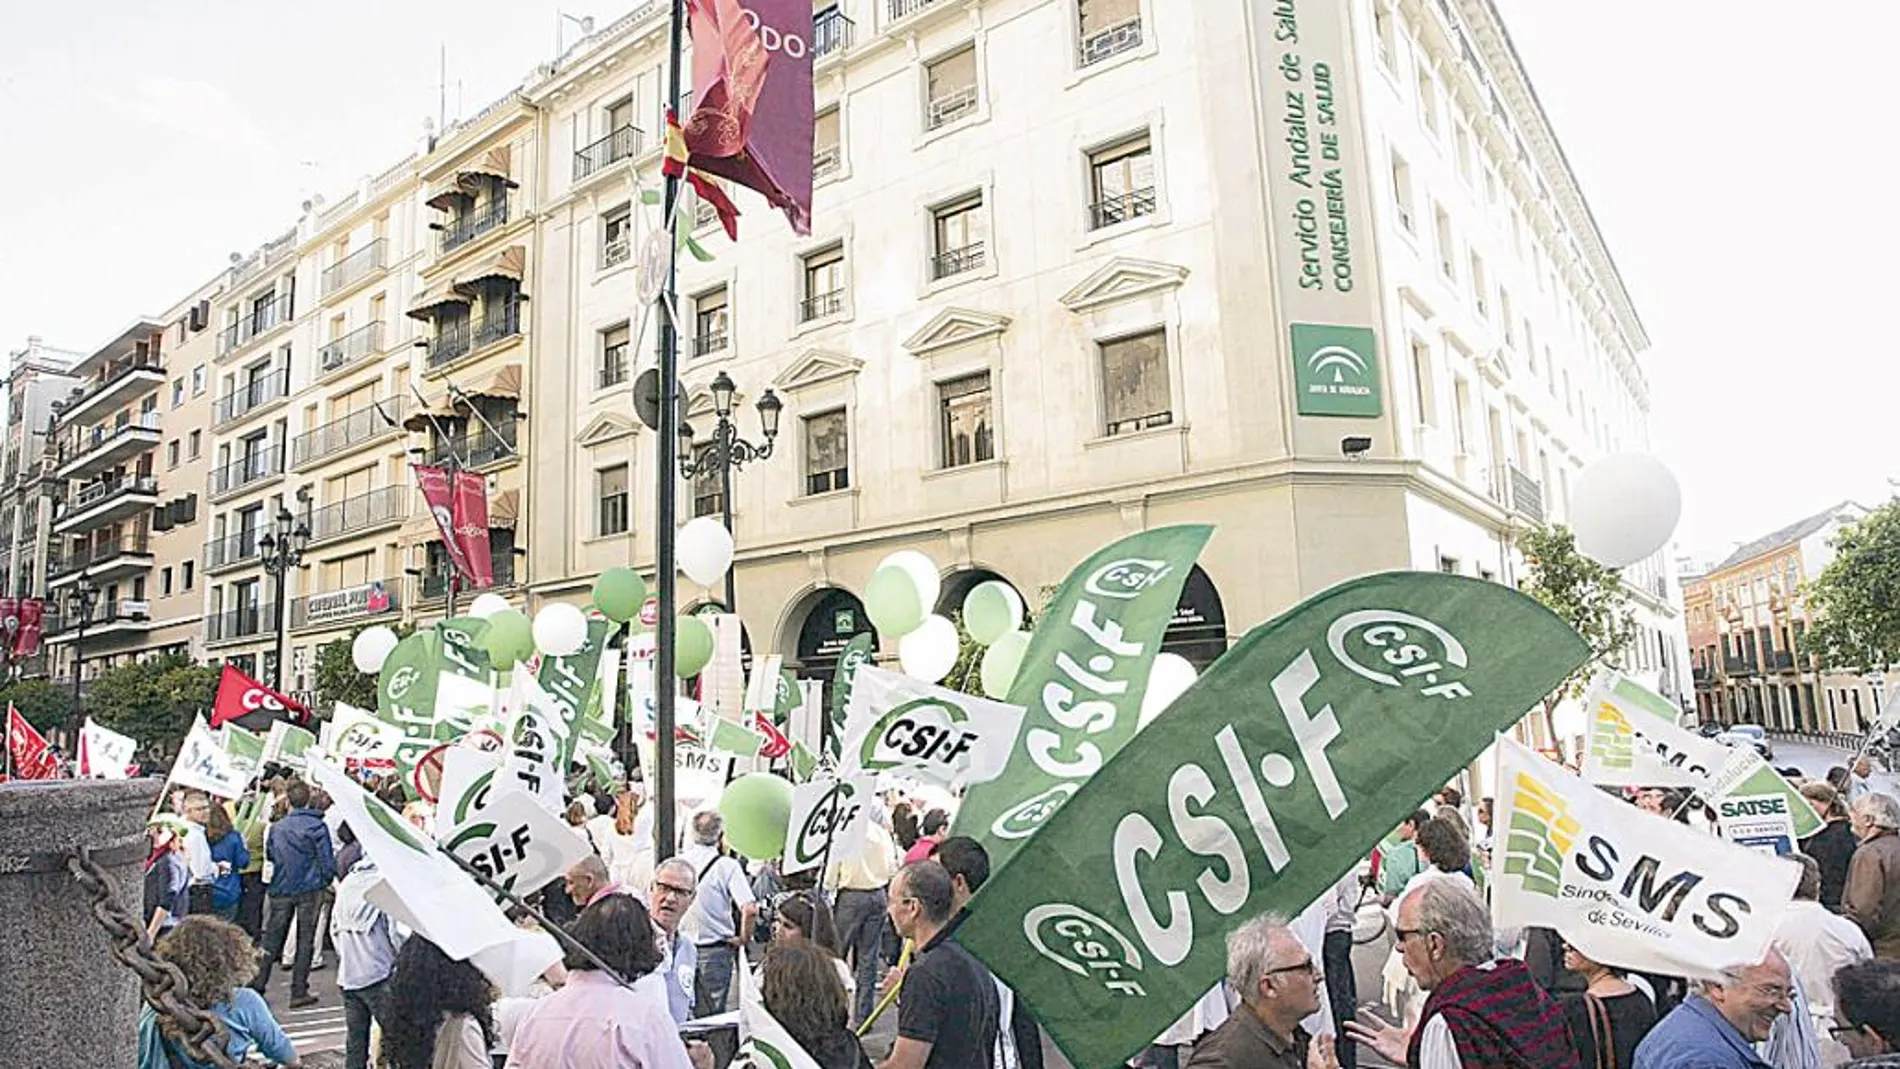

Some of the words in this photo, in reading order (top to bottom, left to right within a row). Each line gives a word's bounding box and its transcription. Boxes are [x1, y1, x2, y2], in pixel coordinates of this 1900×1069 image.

[1278, 52, 1302, 82] de
[1312, 62, 1336, 126] SALUD
[1283, 91, 1313, 189] Andaluz
[1320, 132, 1340, 161] DE
[1292, 199, 1323, 291] Servicio
[1319, 168, 1353, 292] CONSEJERÍA
[1720, 798, 1787, 817] SATSE
[1574, 835, 1752, 939] SMS
[1587, 910, 1607, 925] de
